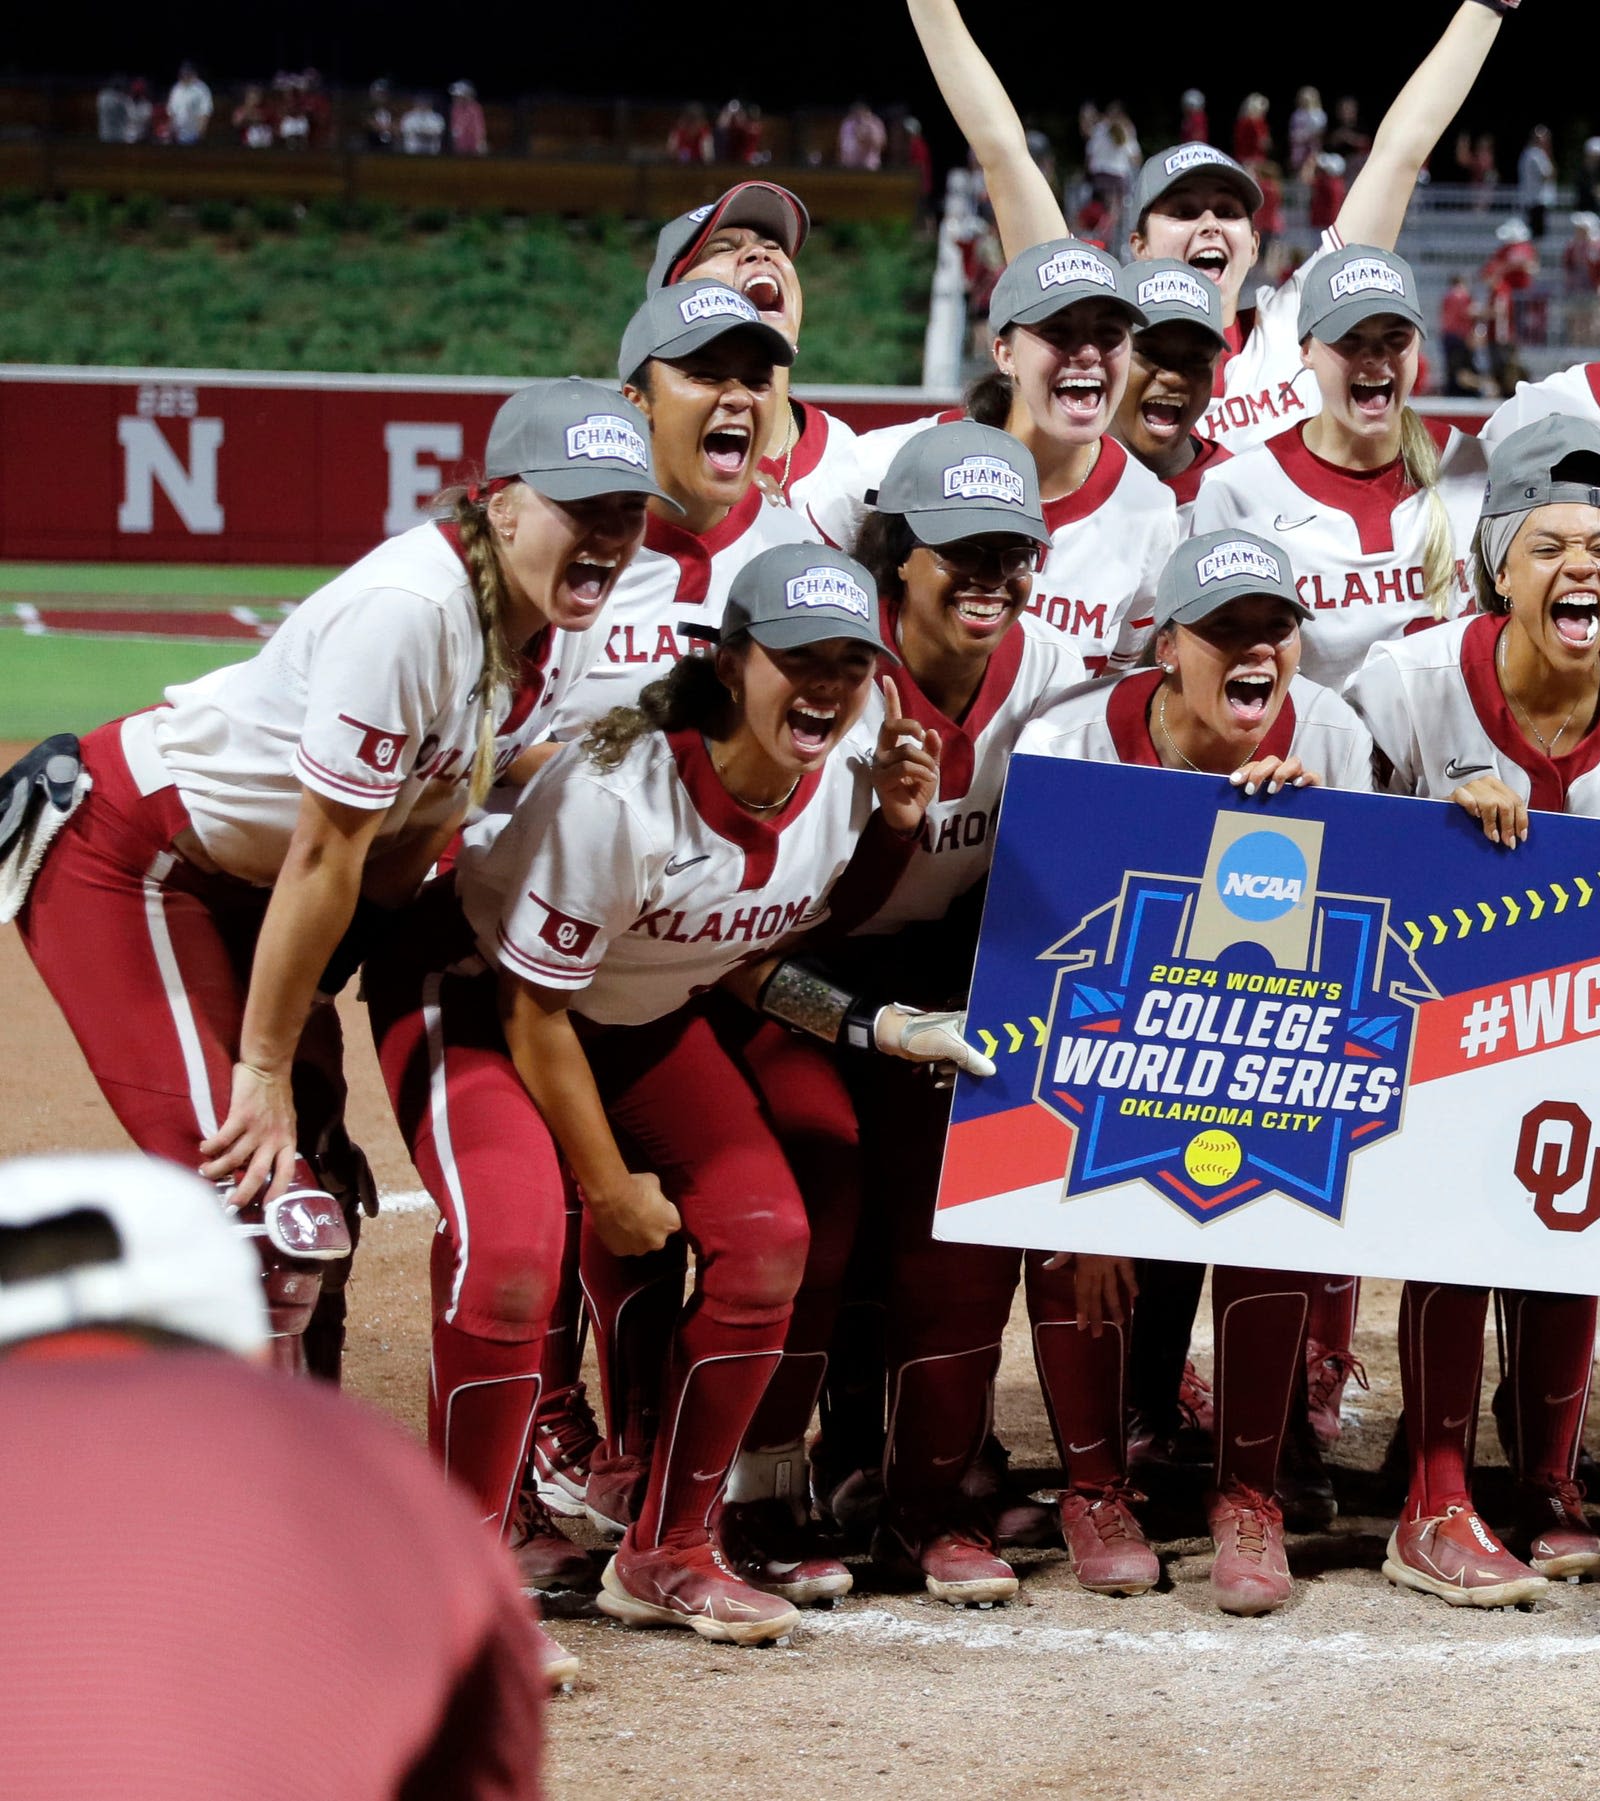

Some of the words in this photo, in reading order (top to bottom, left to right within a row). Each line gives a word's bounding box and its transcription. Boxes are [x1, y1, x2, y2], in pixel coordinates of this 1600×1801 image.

[1045, 259, 1112, 283] CHAMPS
[1336, 269, 1400, 291] CHAMPS
[1143, 281, 1206, 306] CHAMPS
[575, 429, 645, 461] CHAMPS
[950, 469, 1022, 497] CHAMPS
[969, 487, 1008, 497] 2024
[1204, 552, 1276, 577] CHAMPS
[794, 578, 867, 611] CHAMPS
[375, 738, 396, 767] OU
[1223, 872, 1302, 902] NCAA
[556, 922, 580, 949] OU
[1149, 965, 1217, 989] 2024
[1226, 973, 1343, 1001] WOMEN'S
[1133, 990, 1341, 1054] COLLEGE
[1053, 1037, 1227, 1096] WORLD
[1228, 1052, 1398, 1114] SERIES
[1119, 1098, 1254, 1127] OKLAHOMA
[1261, 1110, 1323, 1133] CITY
